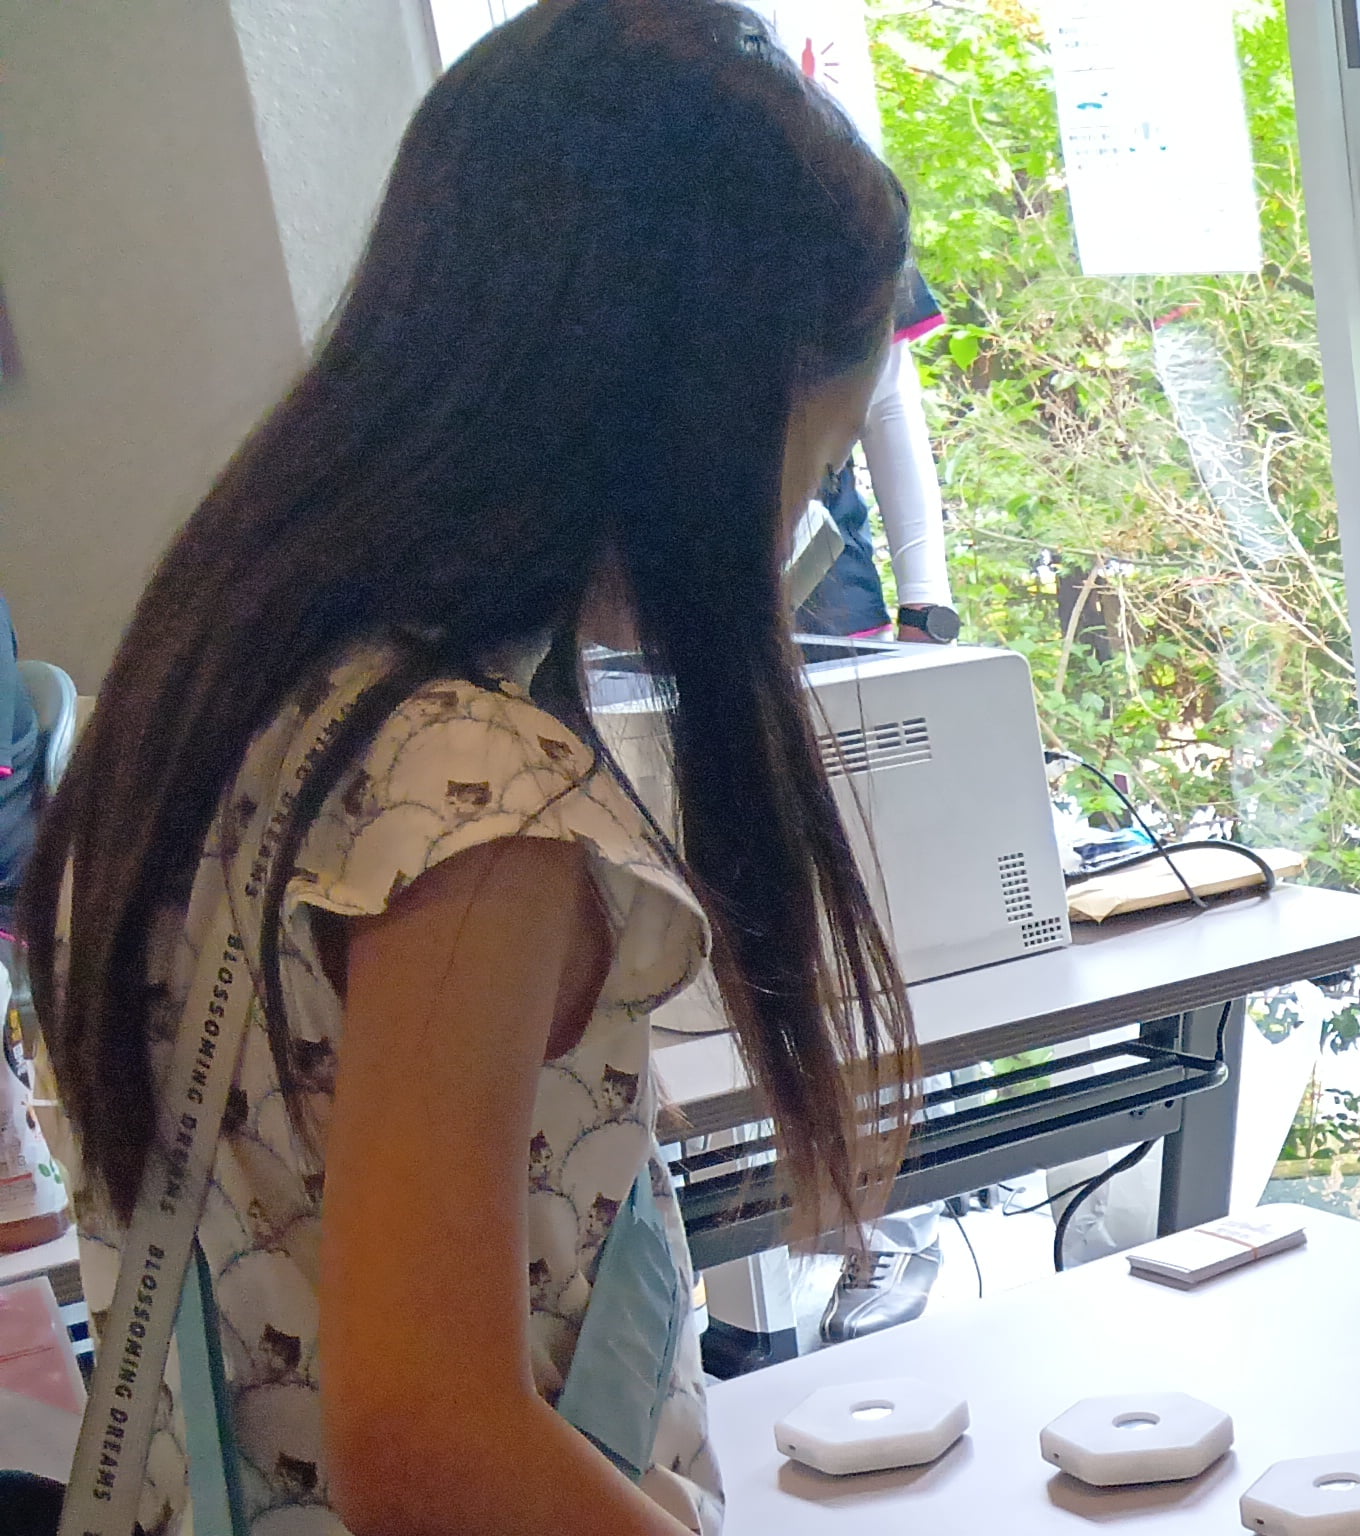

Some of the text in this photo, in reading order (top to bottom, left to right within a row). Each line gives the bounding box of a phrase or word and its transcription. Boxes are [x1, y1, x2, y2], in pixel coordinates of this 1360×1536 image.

[187, 933, 242, 1104] BLOSSOMING
[93, 1245, 165, 1501] BLOSSOMING DREAMS
